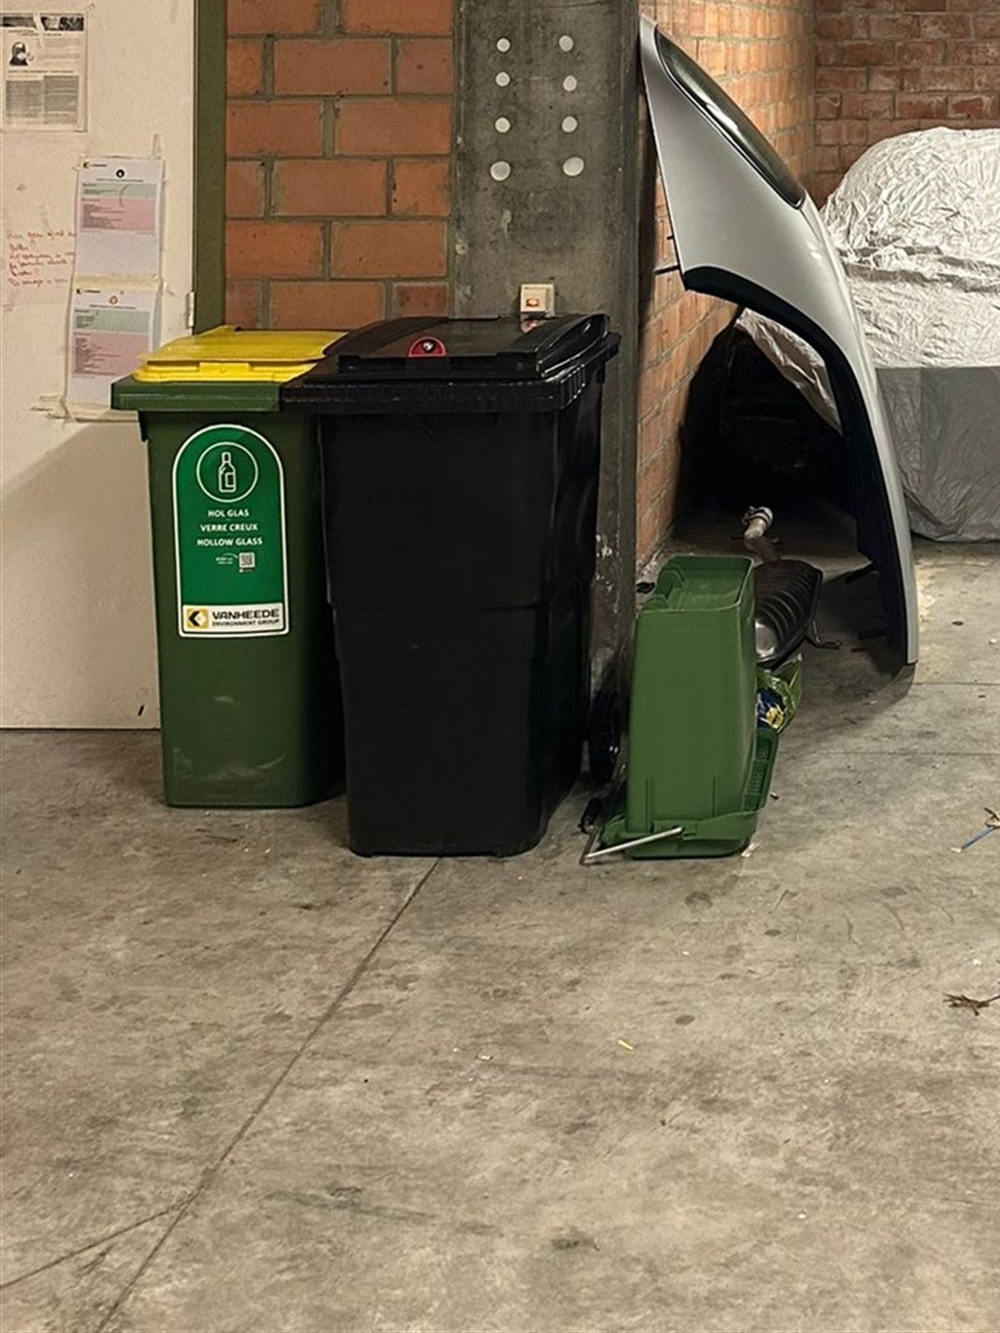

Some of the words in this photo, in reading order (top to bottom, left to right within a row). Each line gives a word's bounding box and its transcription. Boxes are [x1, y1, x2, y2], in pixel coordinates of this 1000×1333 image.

[227, 509, 249, 517] GLAS
[200, 524, 227, 532] VERRE
[229, 523, 258, 531] CREUX
[197, 538, 233, 546] HOLLOW
[235, 537, 263, 546] GLASS
[212, 608, 280, 620] VANHEEDE
